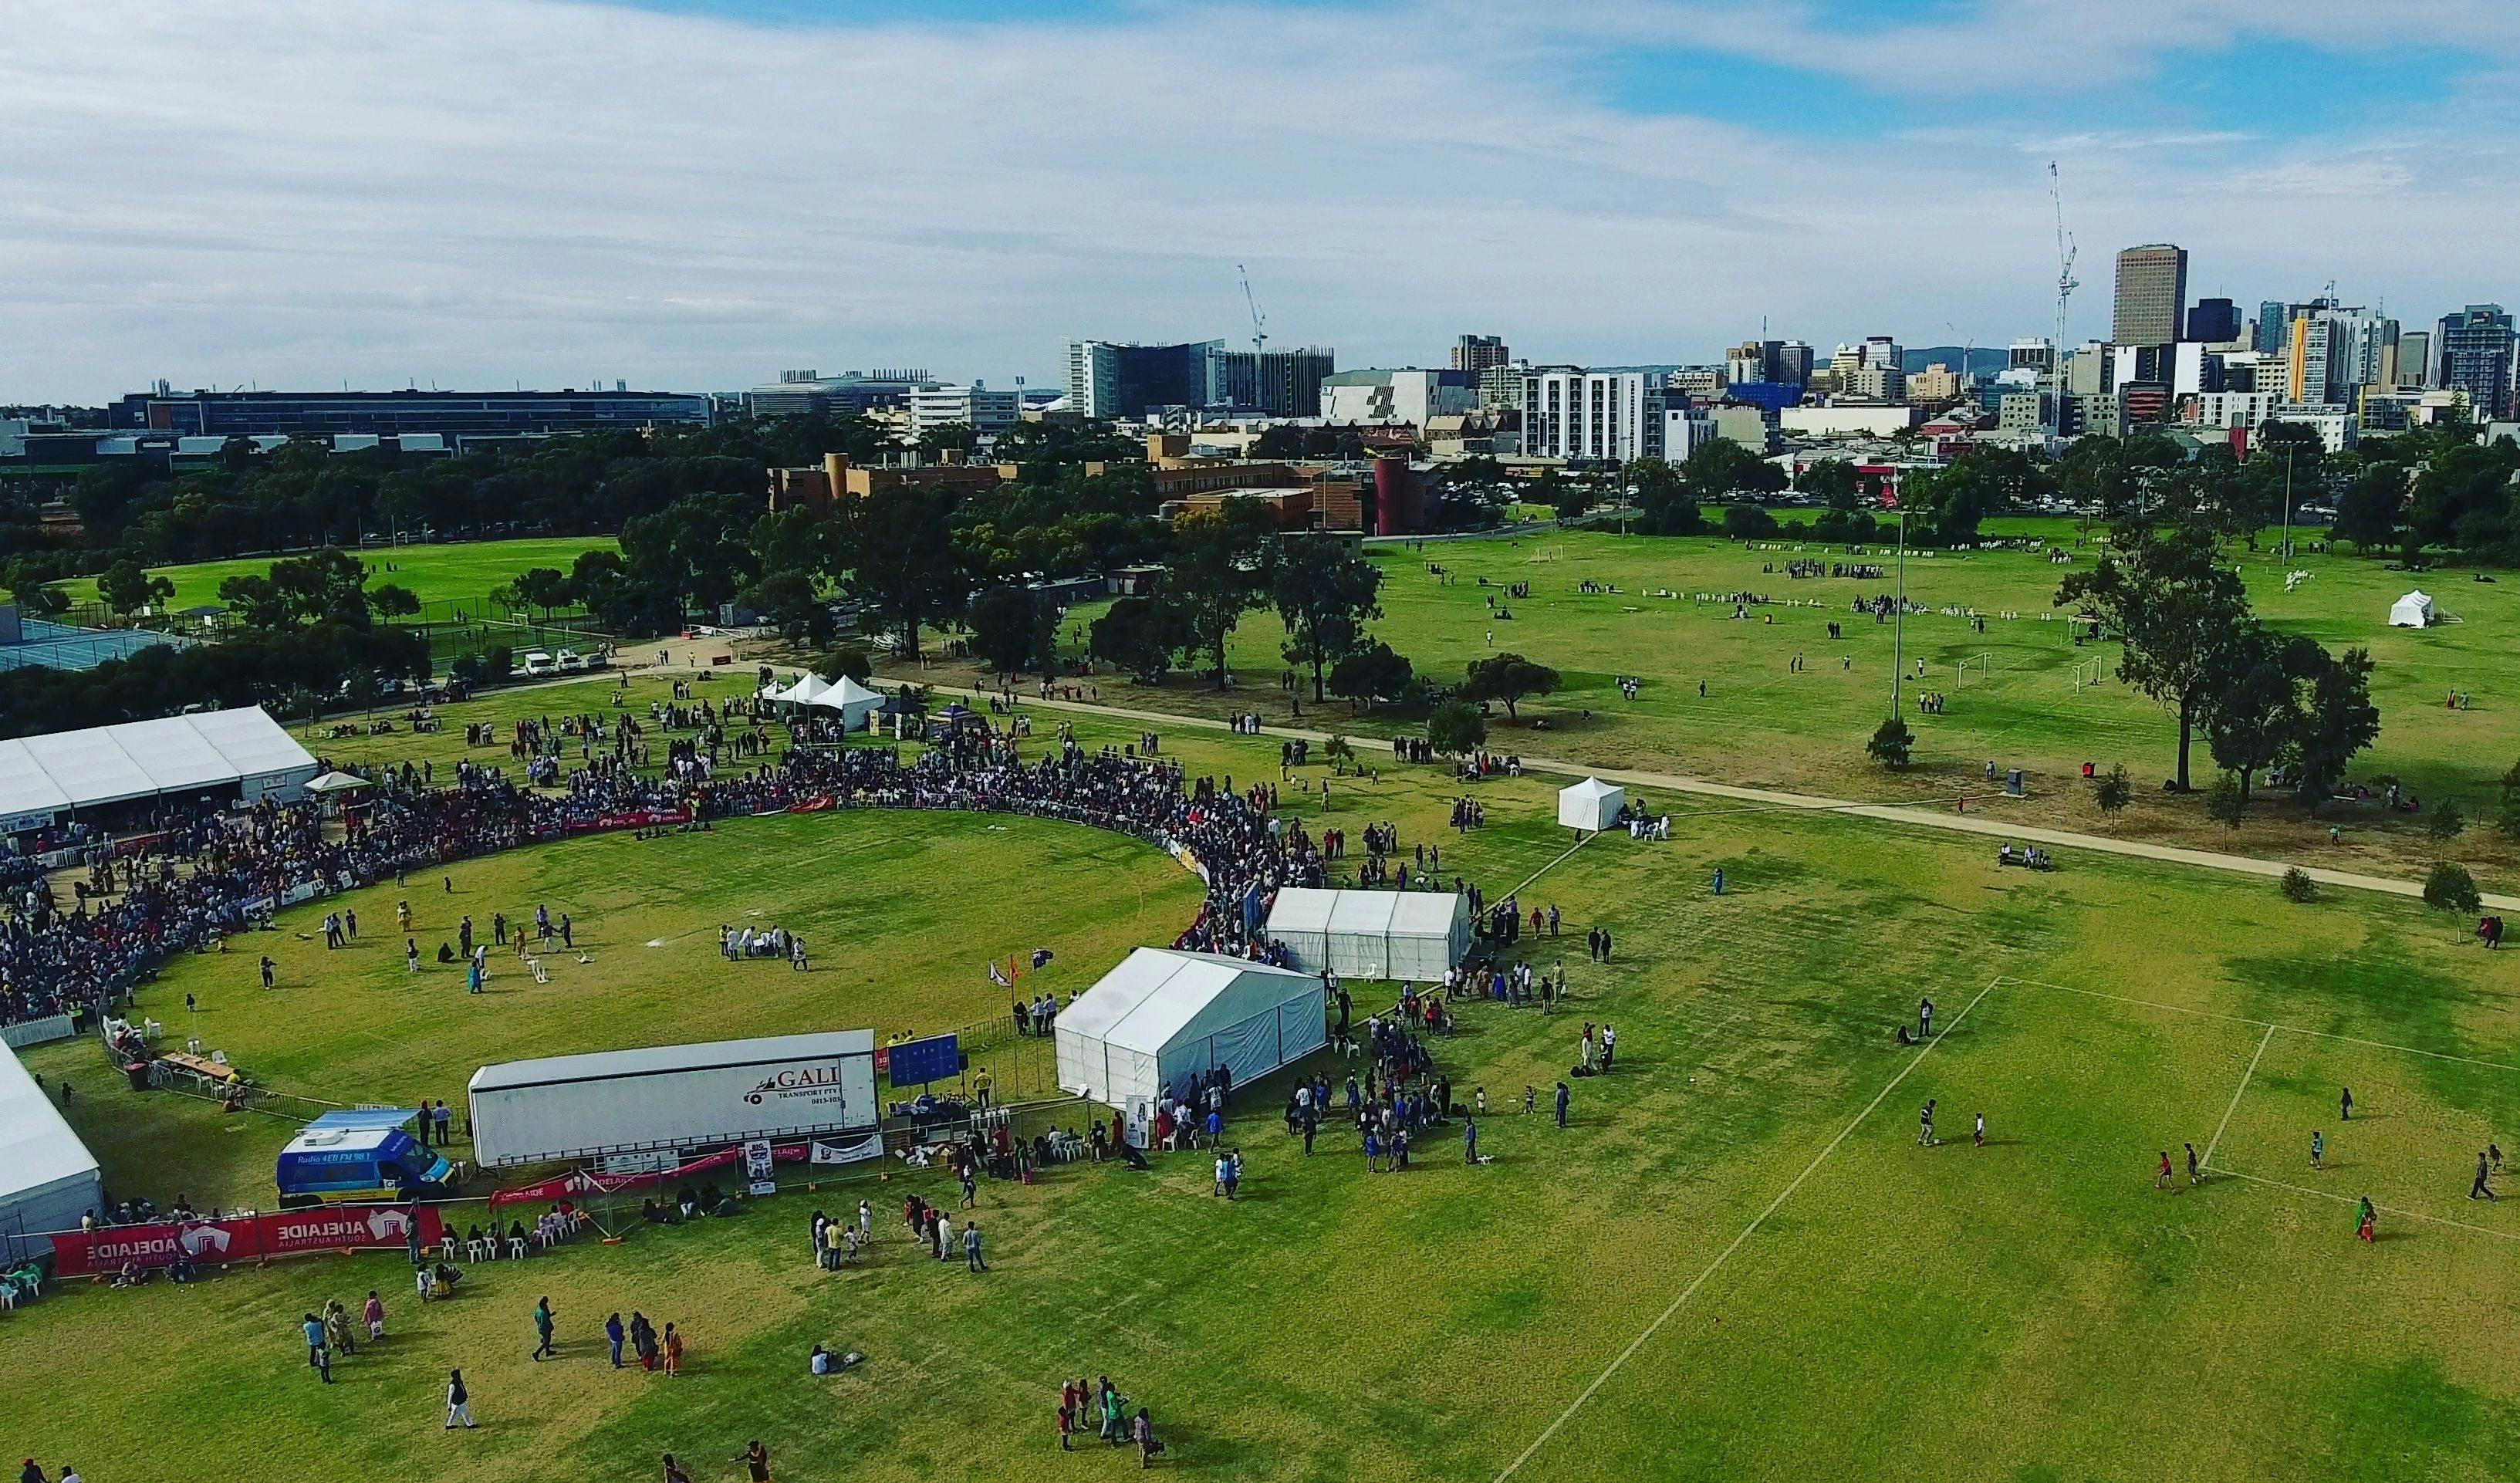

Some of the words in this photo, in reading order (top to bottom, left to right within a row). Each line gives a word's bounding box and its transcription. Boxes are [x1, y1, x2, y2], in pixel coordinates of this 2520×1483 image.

[777, 1066, 839, 1087] GALI
[778, 1089, 823, 1099] TRANSPORT
[298, 1156, 321, 1164] Radio
[340, 1153, 353, 1161] FM
